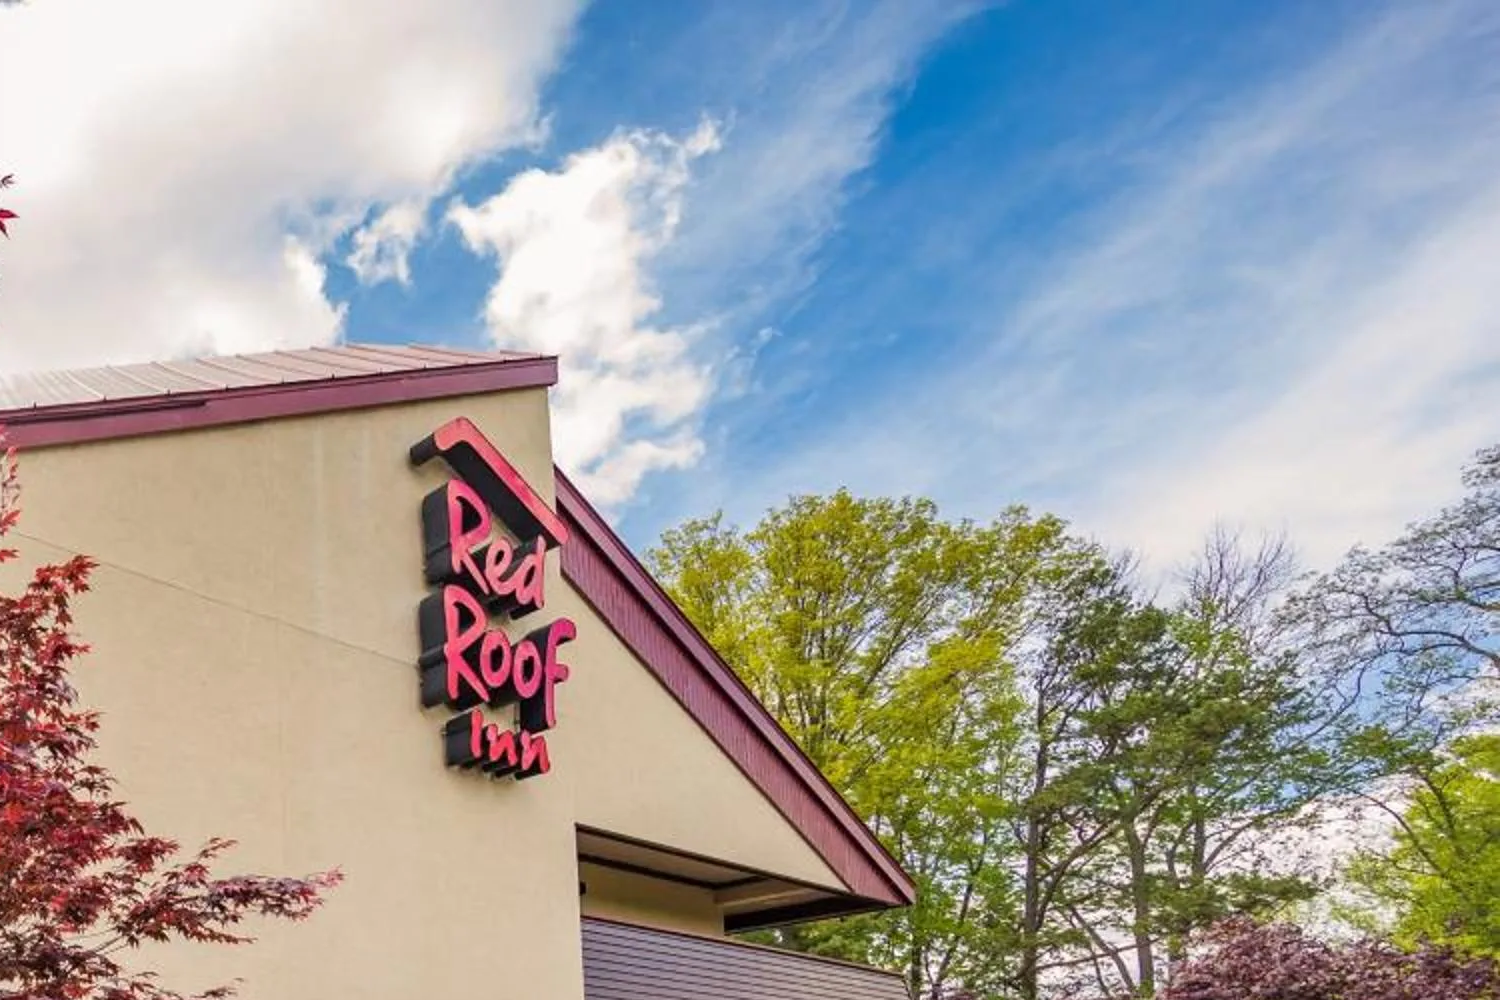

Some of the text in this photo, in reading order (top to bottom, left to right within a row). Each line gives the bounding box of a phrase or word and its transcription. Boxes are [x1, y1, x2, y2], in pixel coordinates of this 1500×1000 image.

[447, 478, 546, 609] Red
[443, 583, 577, 729] Roof
[470, 707, 551, 774] Inn
